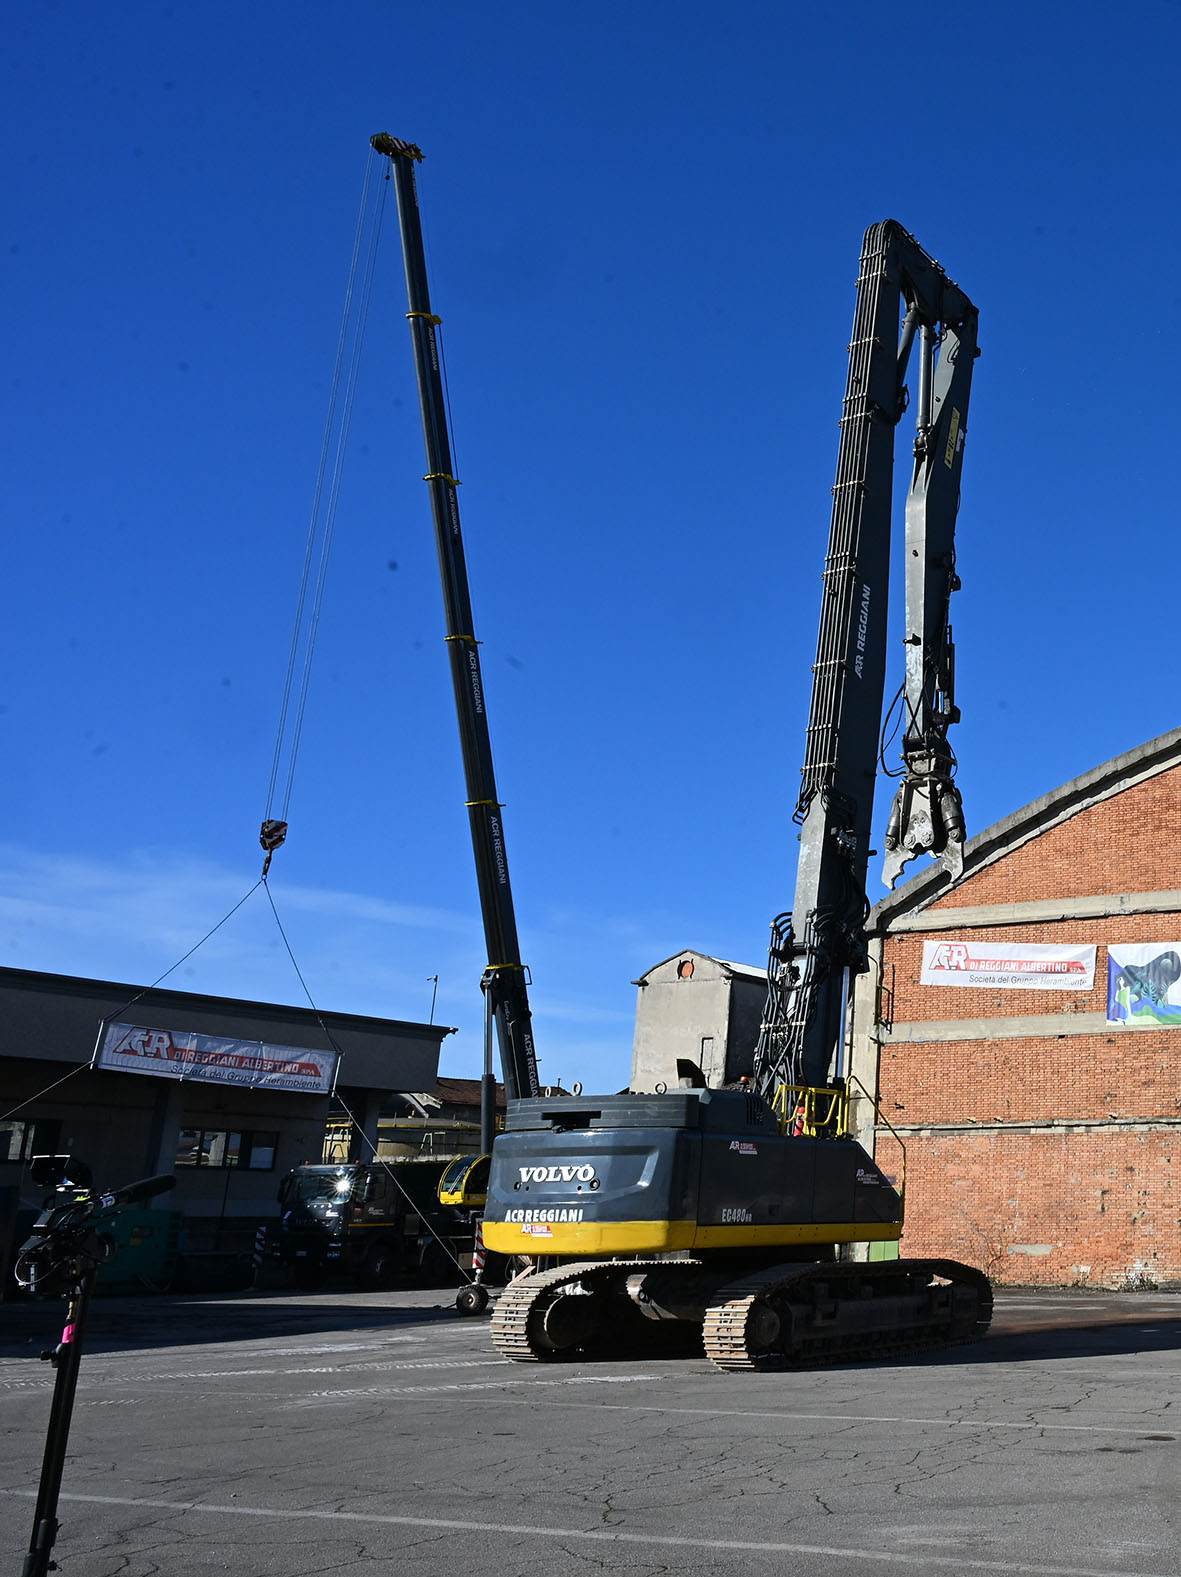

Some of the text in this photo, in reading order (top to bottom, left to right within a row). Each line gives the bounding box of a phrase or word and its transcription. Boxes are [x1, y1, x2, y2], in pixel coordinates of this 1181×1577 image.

[856, 583, 872, 652] REGGIANI
[468, 650, 483, 713] ACR REGGIANI
[491, 814, 507, 884] ACR REGGIANI
[970, 961, 979, 970] DI
[979, 960, 1019, 971] REGGIANI
[1019, 962, 1068, 972] ALBERTINO
[969, 974, 997, 983] Società
[997, 975, 1009, 983] del
[173, 1050, 185, 1062] DI
[187, 1052, 240, 1068] REGGIANI
[242, 1059, 300, 1074] ALBERTINO
[523, 1033, 539, 1098] ACR REGGIA
[209, 1066, 226, 1079] del
[265, 1075, 322, 1090] Herambiente
[518, 1165, 595, 1183] VOLVO
